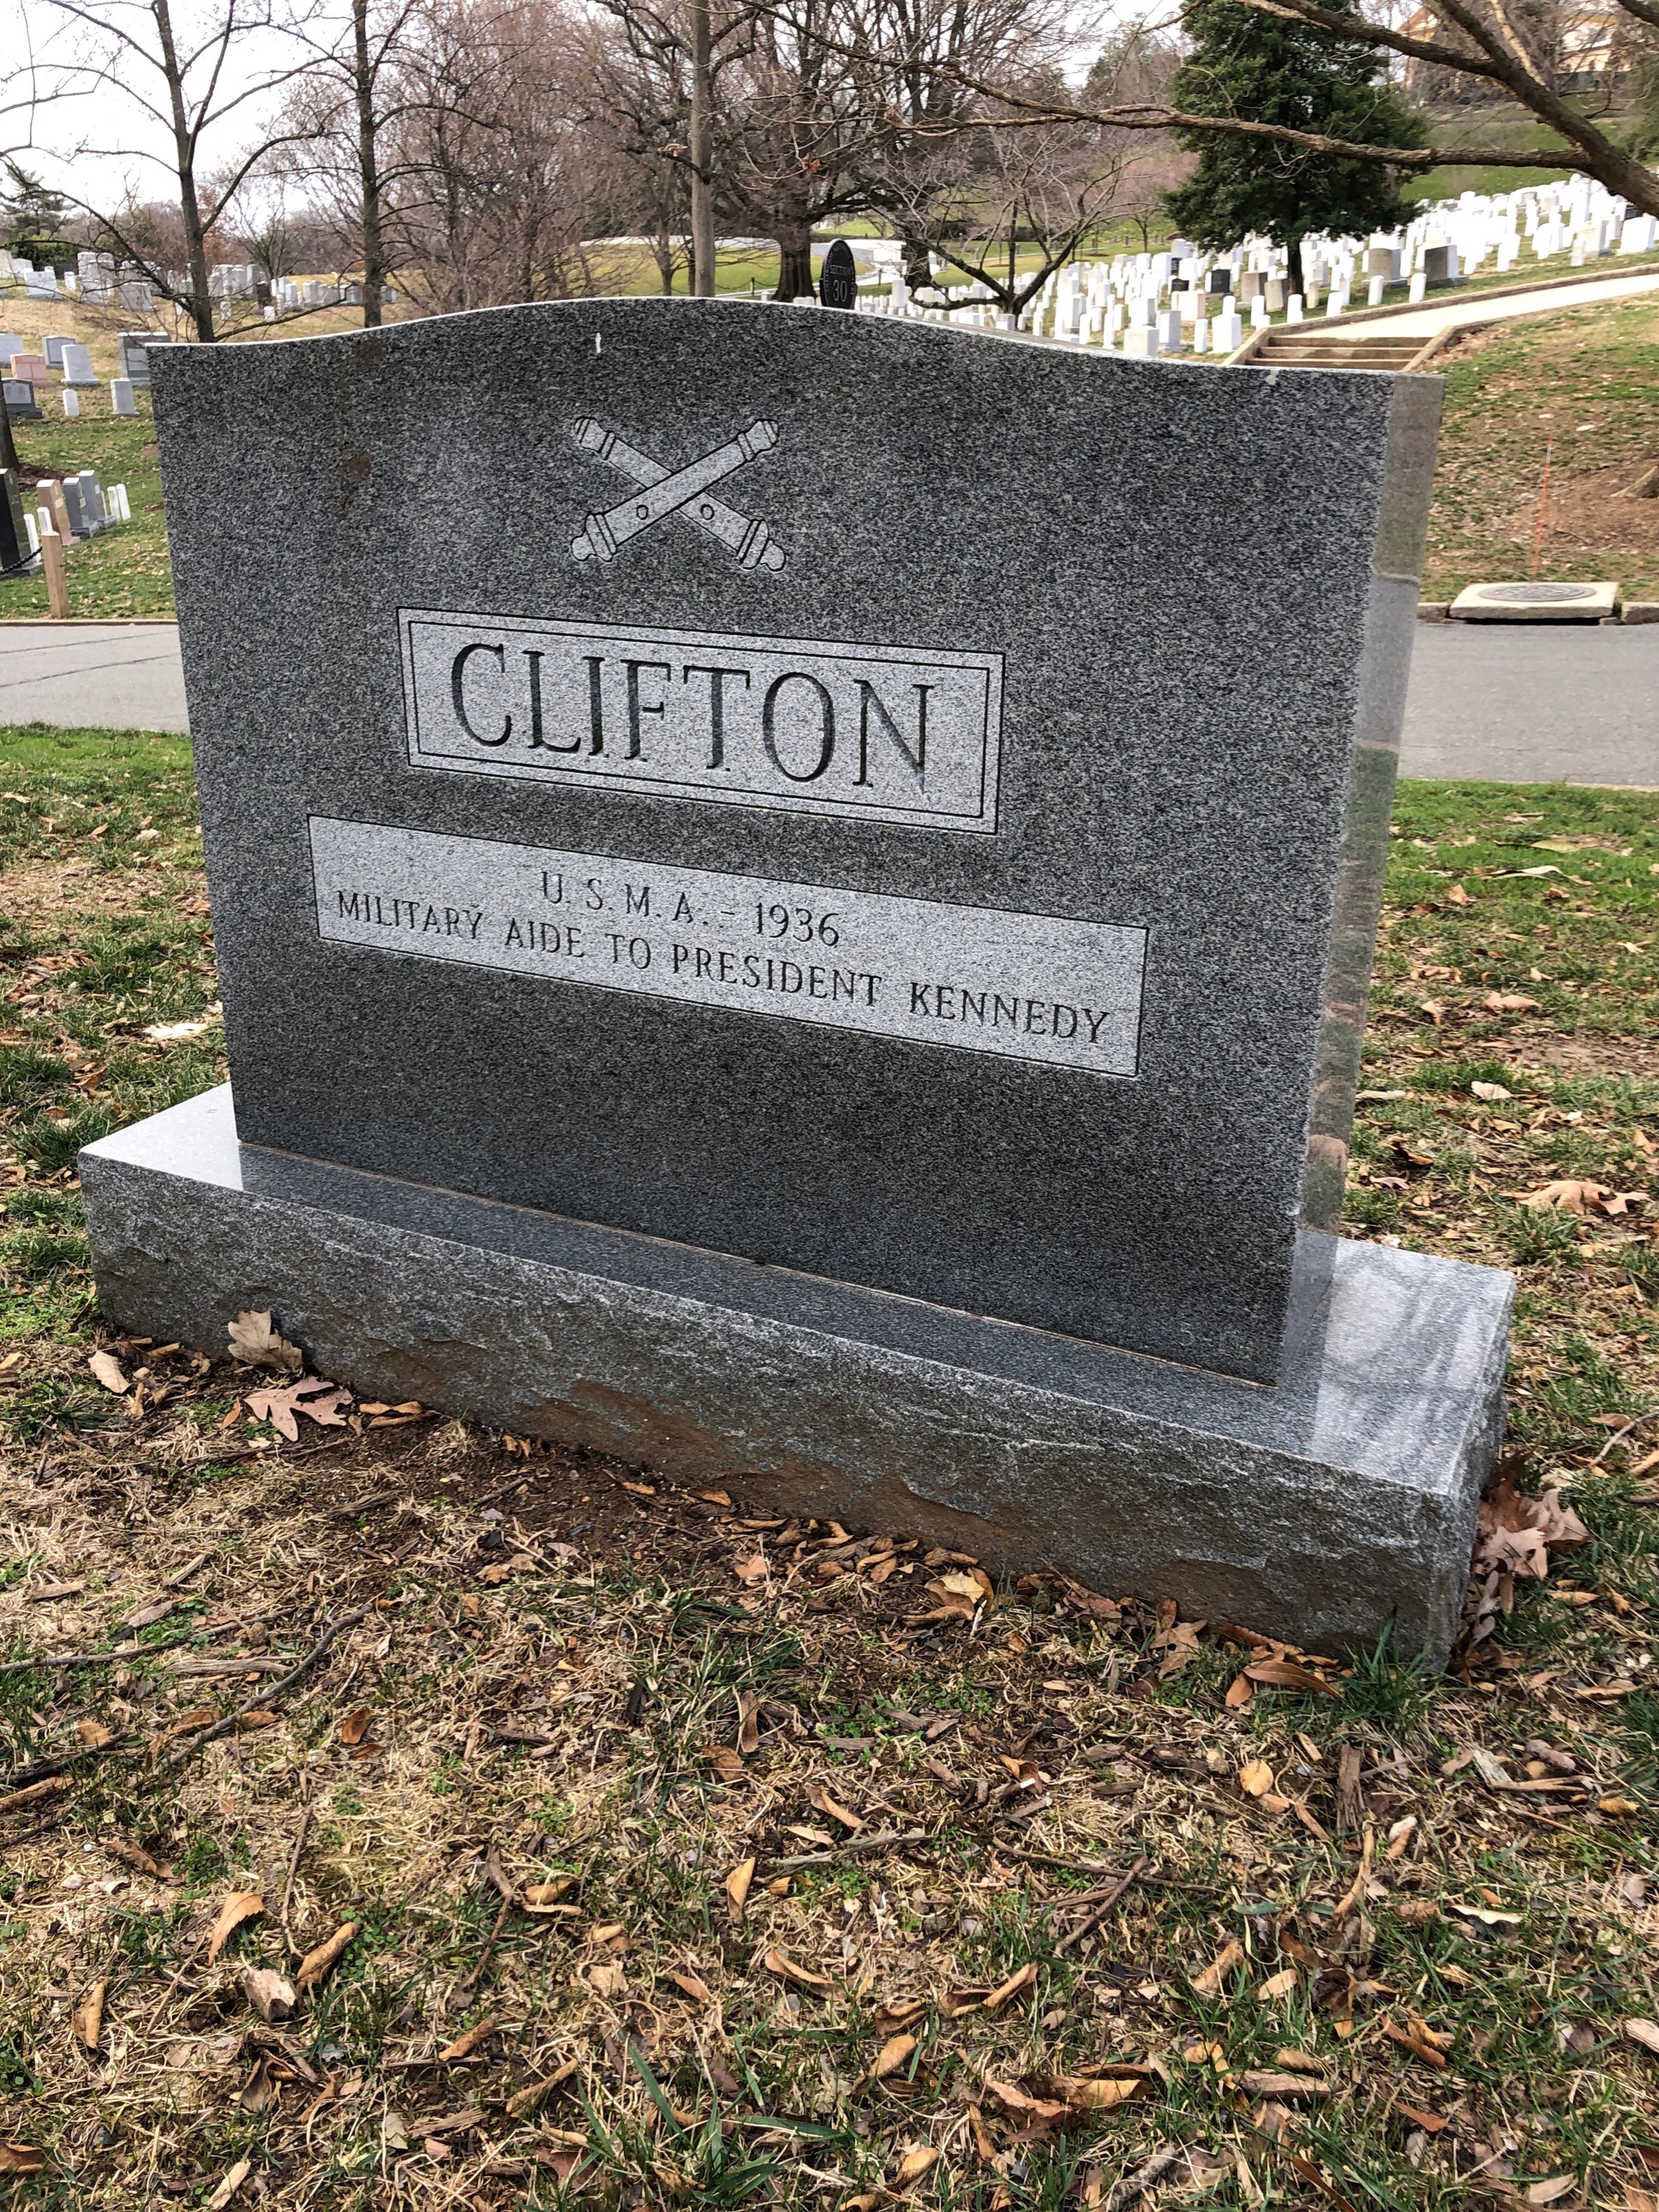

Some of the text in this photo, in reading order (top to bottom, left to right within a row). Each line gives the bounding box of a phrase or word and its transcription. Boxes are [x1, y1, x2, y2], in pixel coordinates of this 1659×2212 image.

[833, 279, 847, 302] 30
[451, 643, 935, 795] CLIFTON
[337, 890, 1110, 1045] MILITARY AIDE TO PRESIDENT KENNEDY
